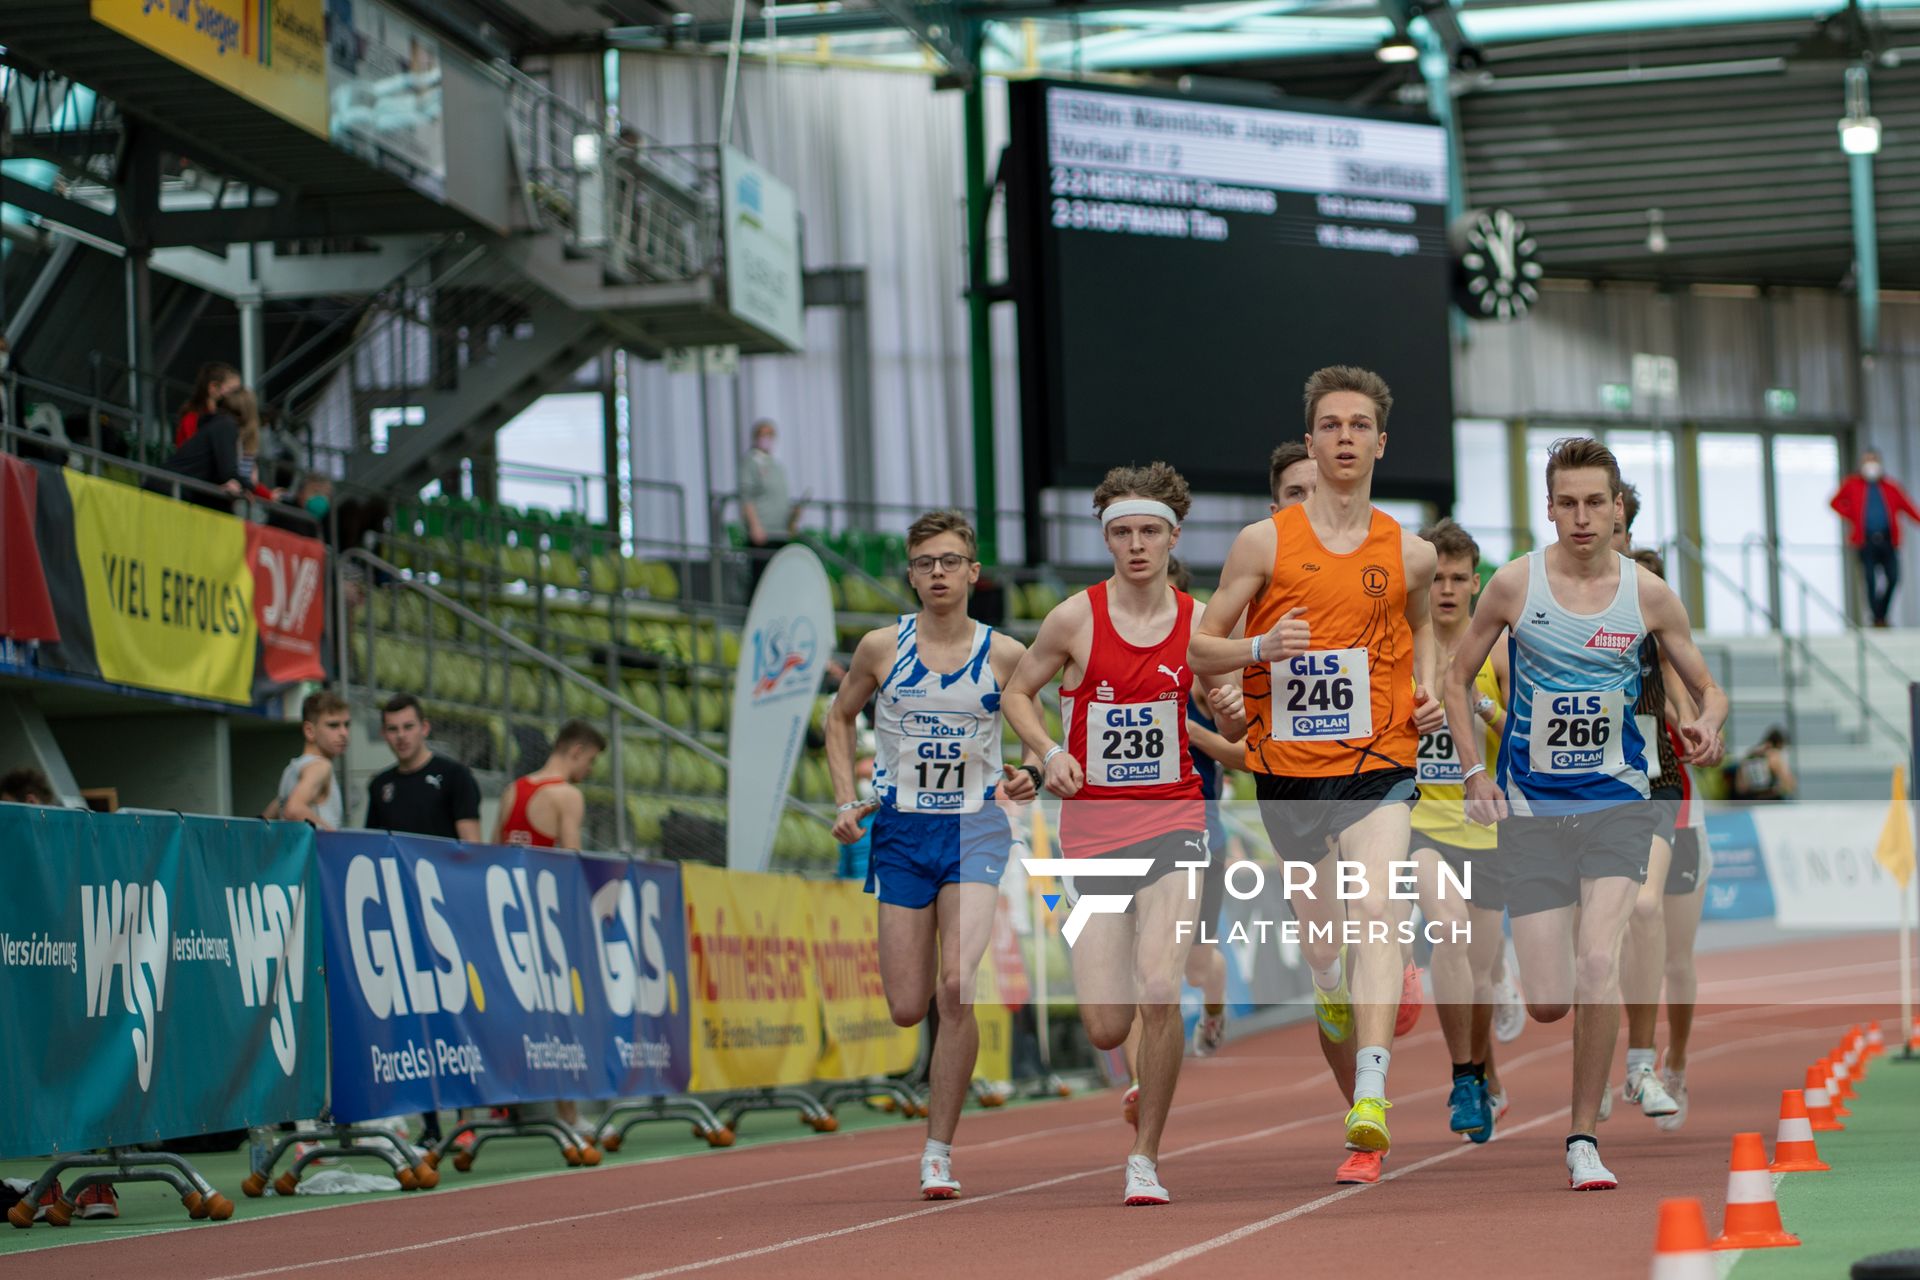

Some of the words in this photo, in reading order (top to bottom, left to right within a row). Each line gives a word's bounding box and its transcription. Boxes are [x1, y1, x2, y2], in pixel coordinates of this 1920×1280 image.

[102, 551, 150, 621] VIEL
[1594, 633, 1631, 648] elsässer
[1286, 677, 1354, 712] 246
[931, 725, 966, 737] KÖLN
[1315, 717, 1348, 729] PLAN
[1546, 716, 1611, 747] 266
[1102, 728, 1165, 760] 238
[1573, 751, 1603, 763] PLAN
[914, 761, 966, 790] 171
[1128, 764, 1159, 774] PLAN
[936, 793, 963, 804] PLAN
[0, 931, 78, 975] Versicherung
[370, 1039, 427, 1084] Parcels
[434, 1036, 486, 1085] People
